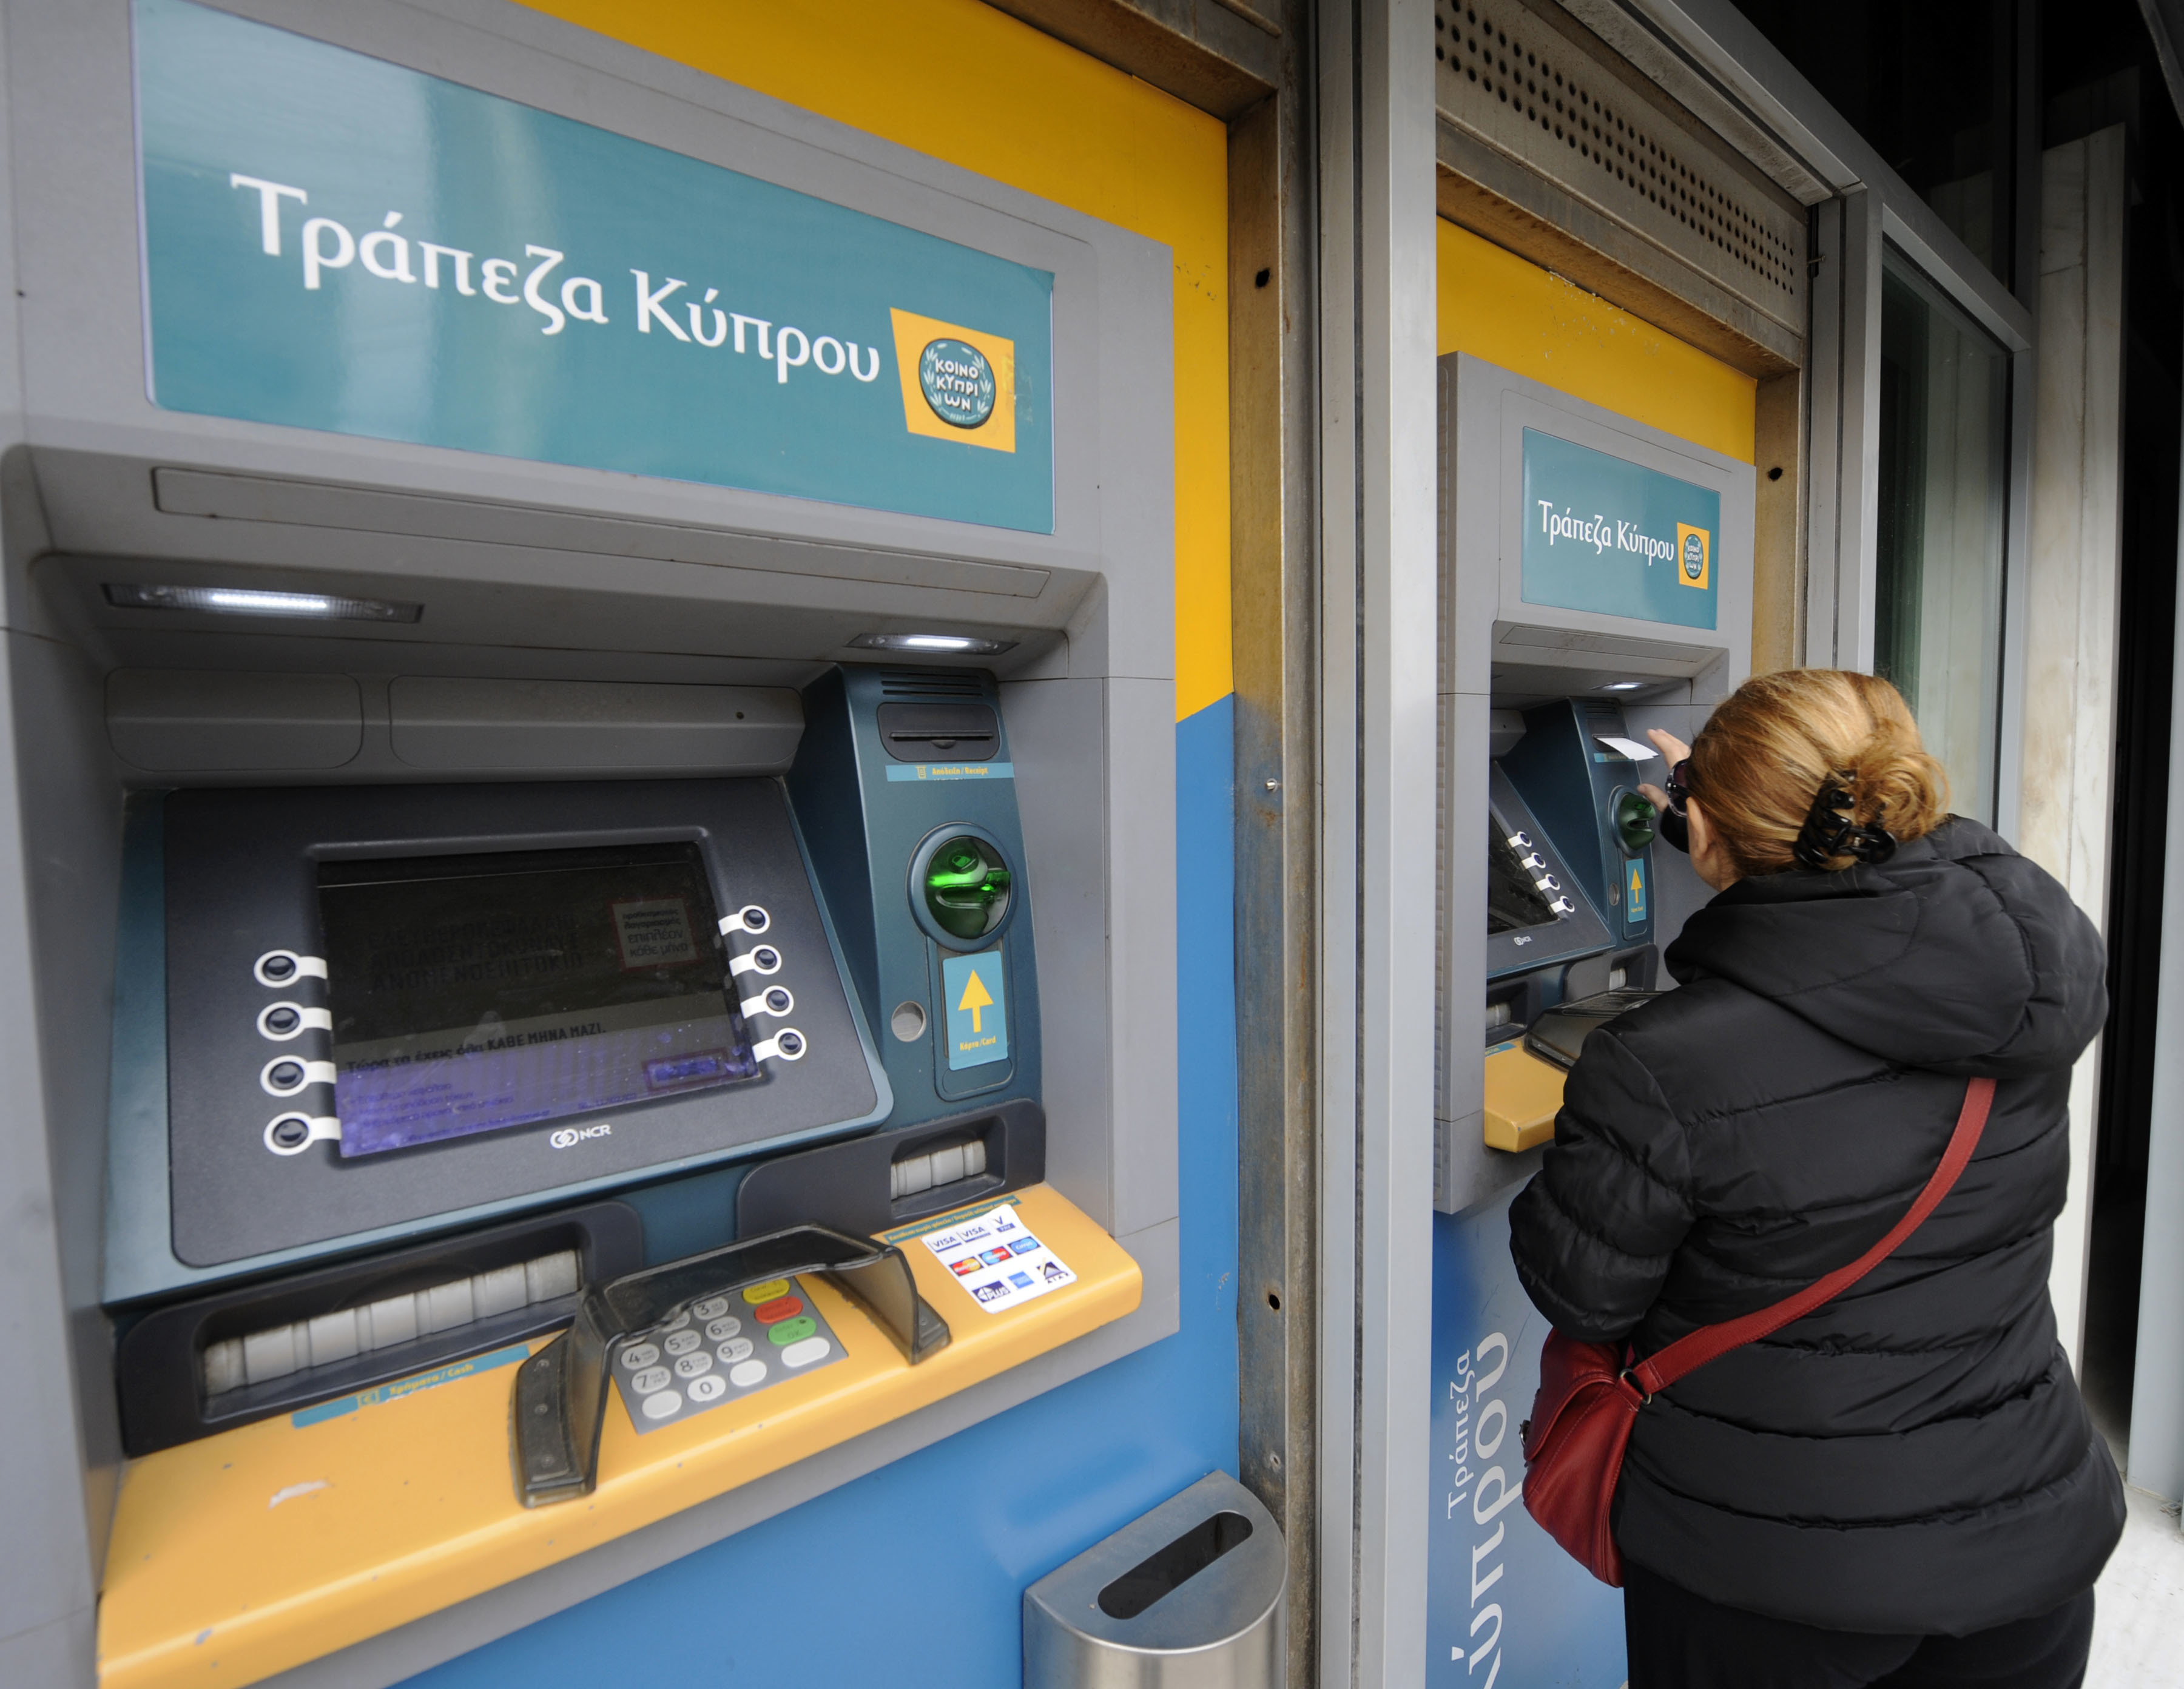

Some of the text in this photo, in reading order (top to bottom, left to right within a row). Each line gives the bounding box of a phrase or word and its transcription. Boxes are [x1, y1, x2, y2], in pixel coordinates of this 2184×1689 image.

[231, 174, 880, 383] Τράπεζα Κύπρου
[935, 359, 979, 379] ΚΟΙΝΟ
[936, 374, 979, 397] ΚΥΠΡΙ
[1538, 499, 1674, 567] Τράπεζα Κύπρου
[627, 926, 683, 944] επιπλέον
[487, 1033, 525, 1051] ΚΑΘΕ
[527, 1027, 567, 1045] ΜΗΝΑ
[579, 1124, 612, 1142] NCR
[962, 1226, 985, 1238] VISA
[933, 1236, 957, 1247] VISA
[988, 1287, 1009, 1301] PLUS
[698, 1305, 709, 1315] 3
[710, 1324, 722, 1335] 6
[669, 1339, 680, 1350] 5
[629, 1352, 641, 1363] 4
[721, 1346, 733, 1358] 9
[448, 1363, 474, 1377] Cash
[680, 1360, 692, 1373] 8
[637, 1375, 647, 1388] 7
[699, 1381, 712, 1394] 0
[1448, 1350, 1475, 1520] Τράπεζα
[1452, 1332, 1522, 1689] ύπρου
